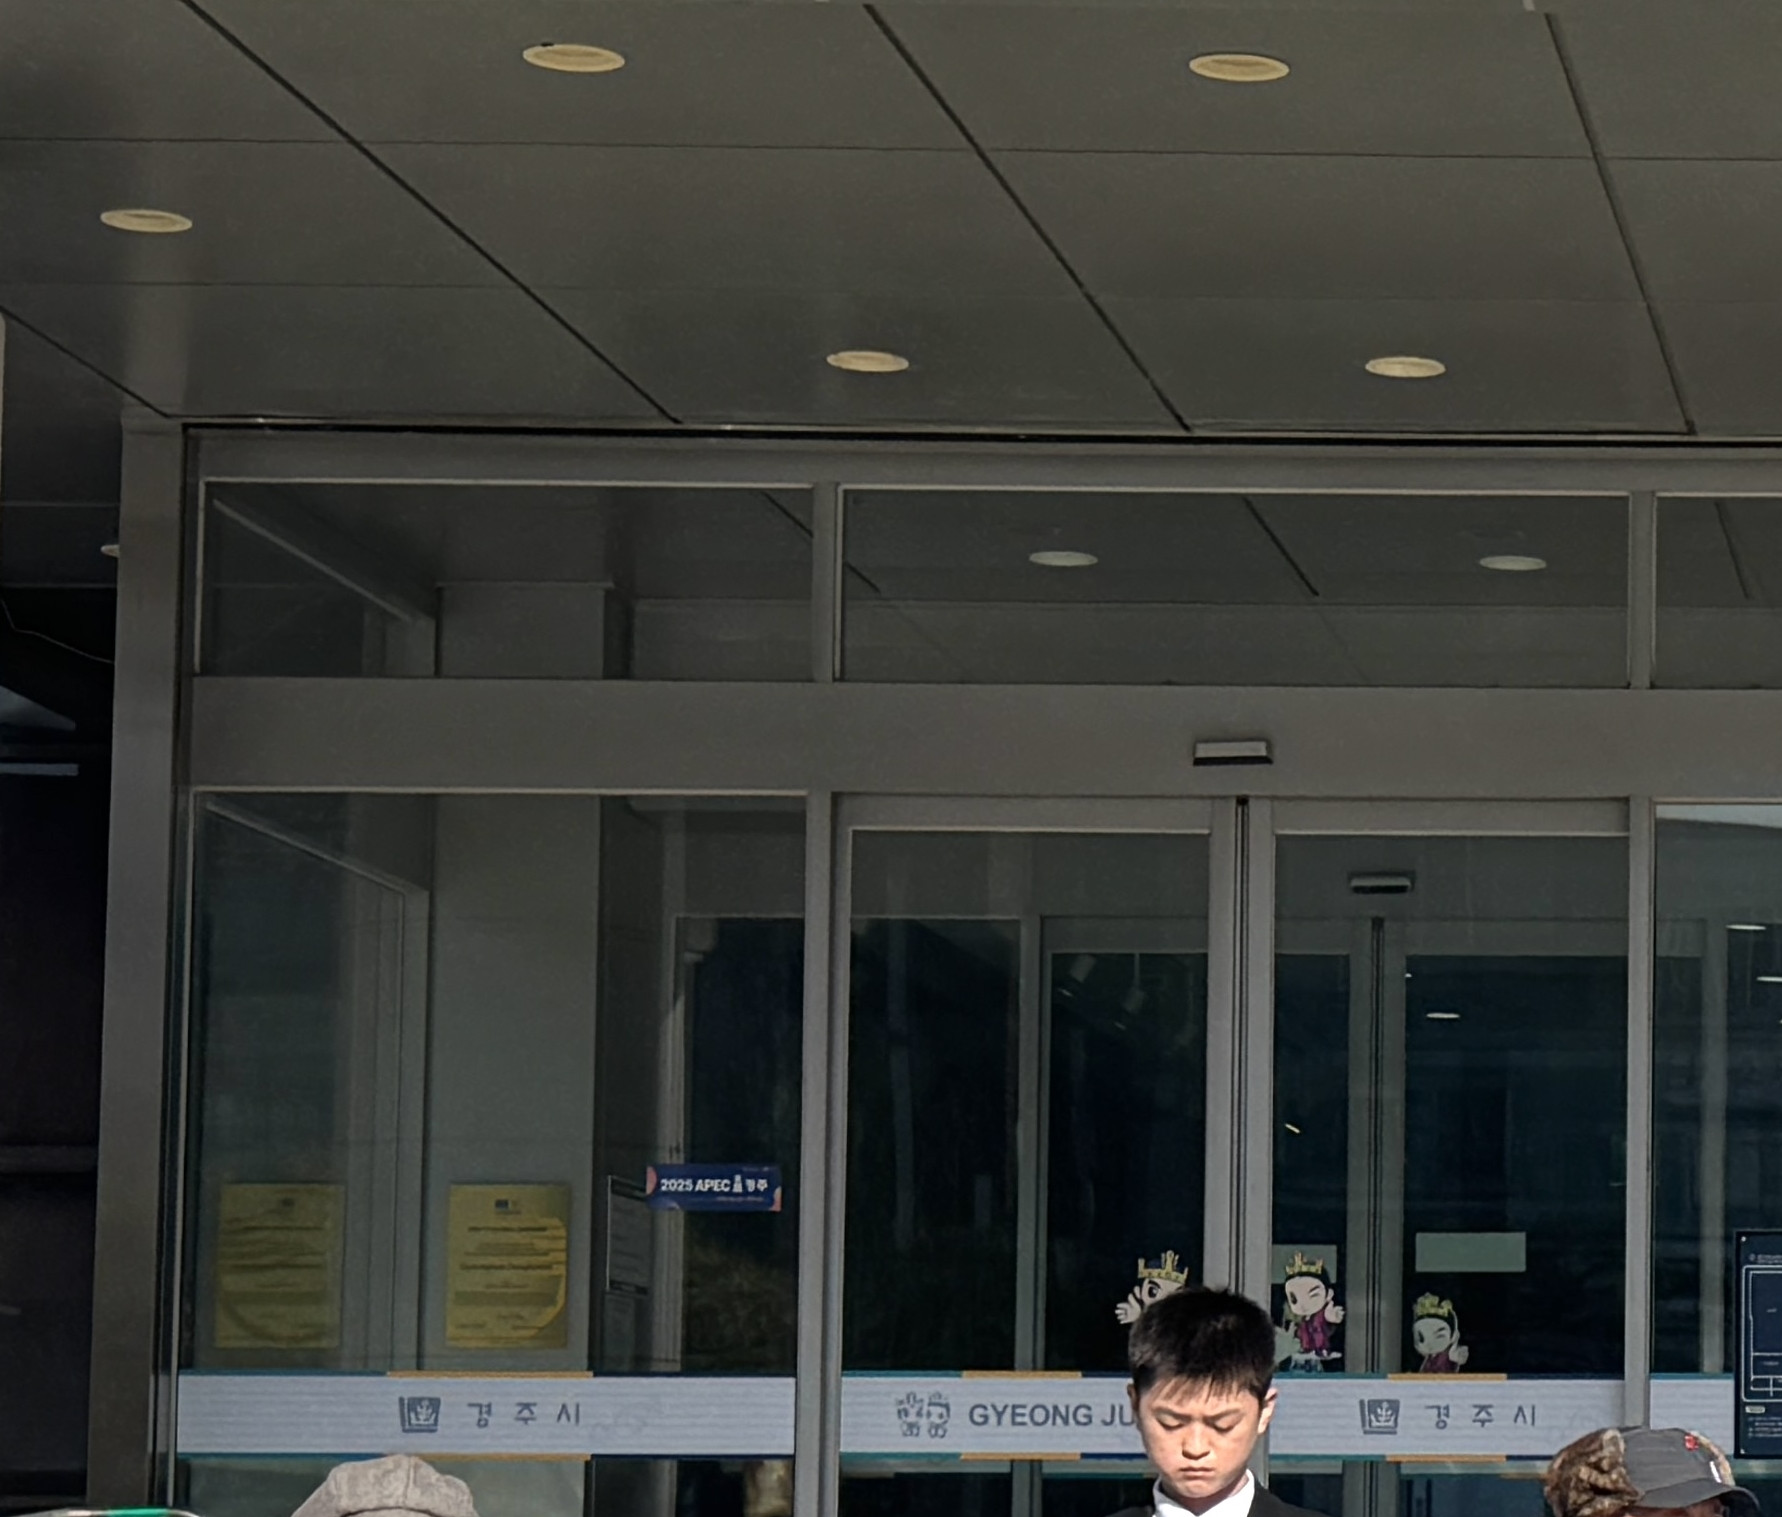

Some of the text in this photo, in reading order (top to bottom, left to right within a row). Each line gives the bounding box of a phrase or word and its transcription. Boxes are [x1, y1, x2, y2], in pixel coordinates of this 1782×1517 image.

[660, 1178, 693, 1192] 2025
[694, 1178, 731, 1192] APEC
[467, 1401, 580, 1429] 경주시
[968, 1404, 1136, 1427] GYEONG JU
[1425, 1404, 1536, 1430] 경주시
